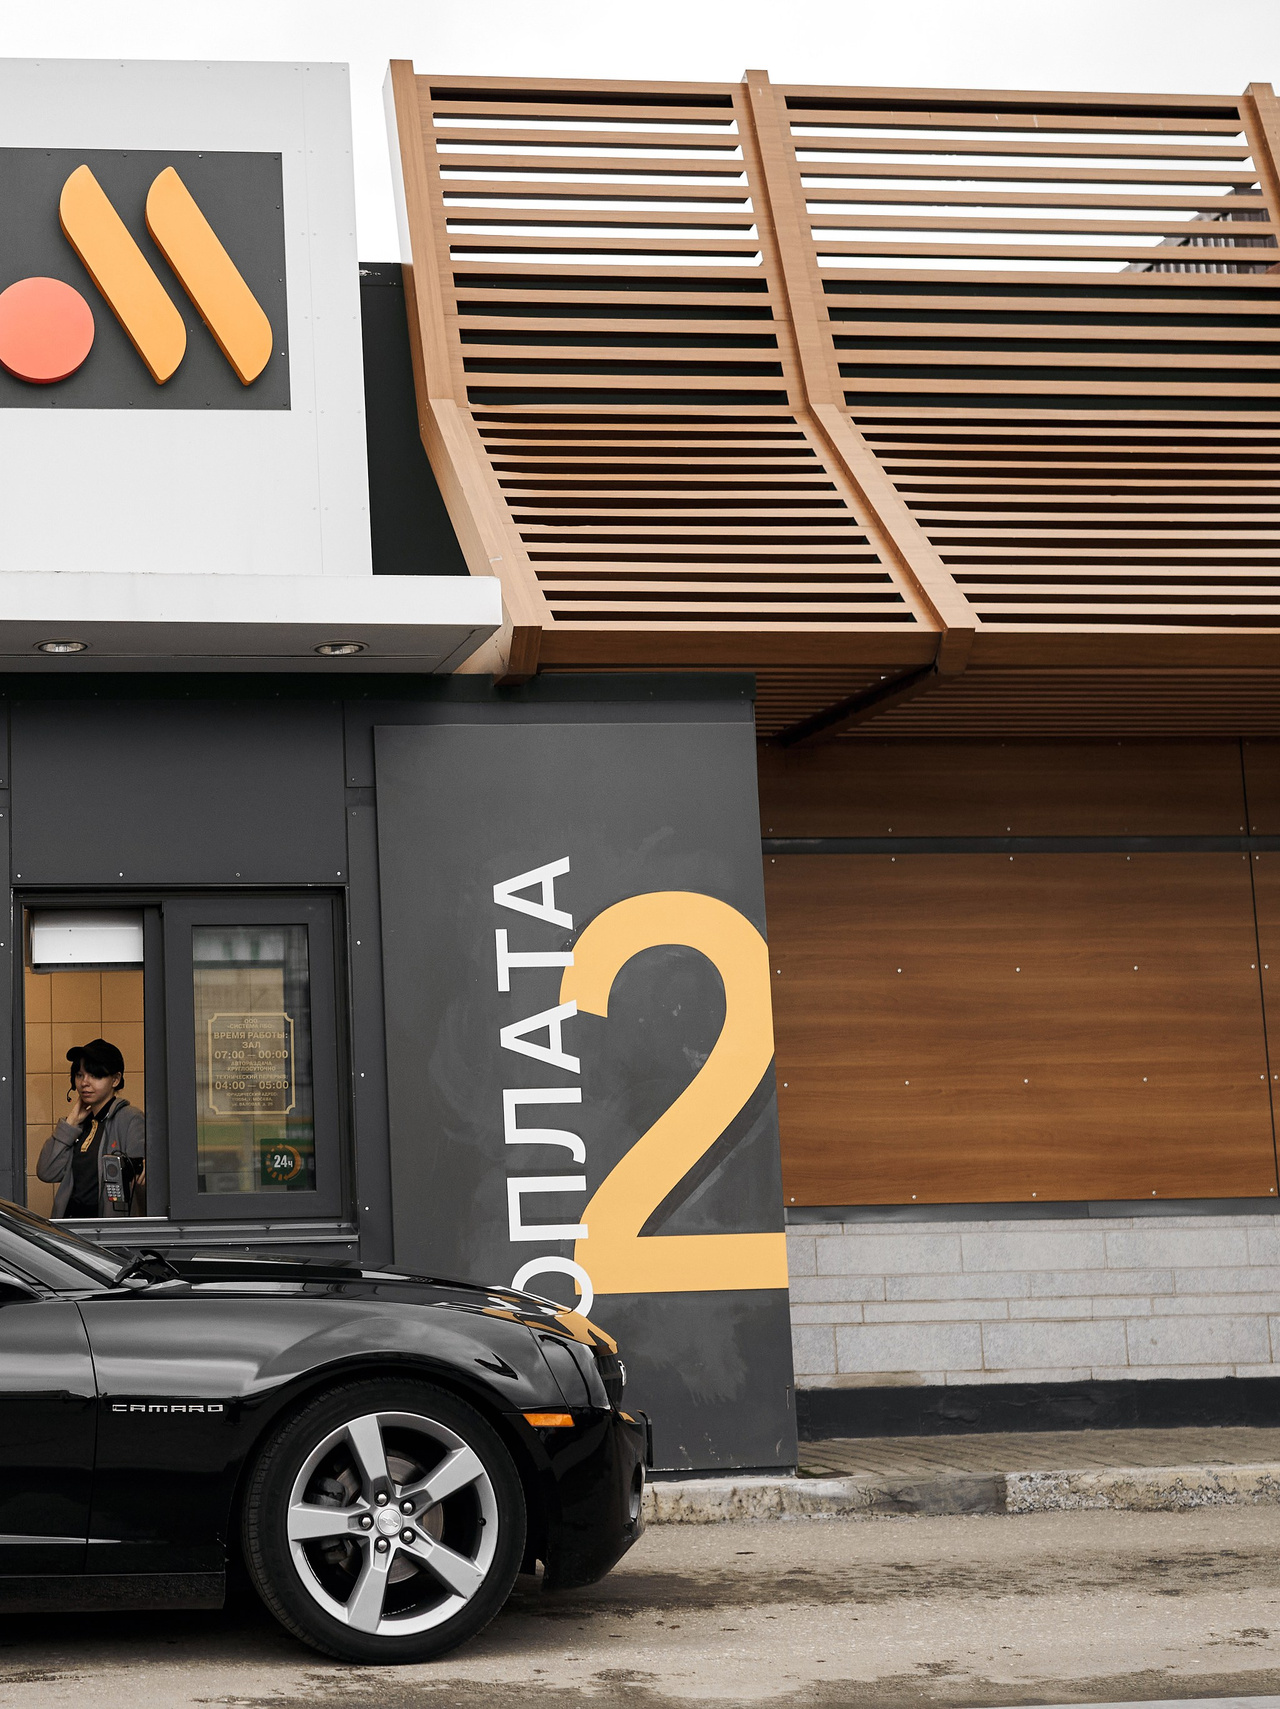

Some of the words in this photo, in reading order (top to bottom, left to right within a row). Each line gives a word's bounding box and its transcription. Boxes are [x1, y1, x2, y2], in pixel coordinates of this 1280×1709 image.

[248, 1031, 288, 1039] РАБОТЫ:
[215, 1050, 244, 1059] 07:00
[258, 1050, 288, 1059] 00:00
[215, 1081, 245, 1089] 04:00
[259, 1081, 289, 1089] 05:00
[559, 891, 789, 1295] 2
[112, 1404, 223, 1413] CAMARO
